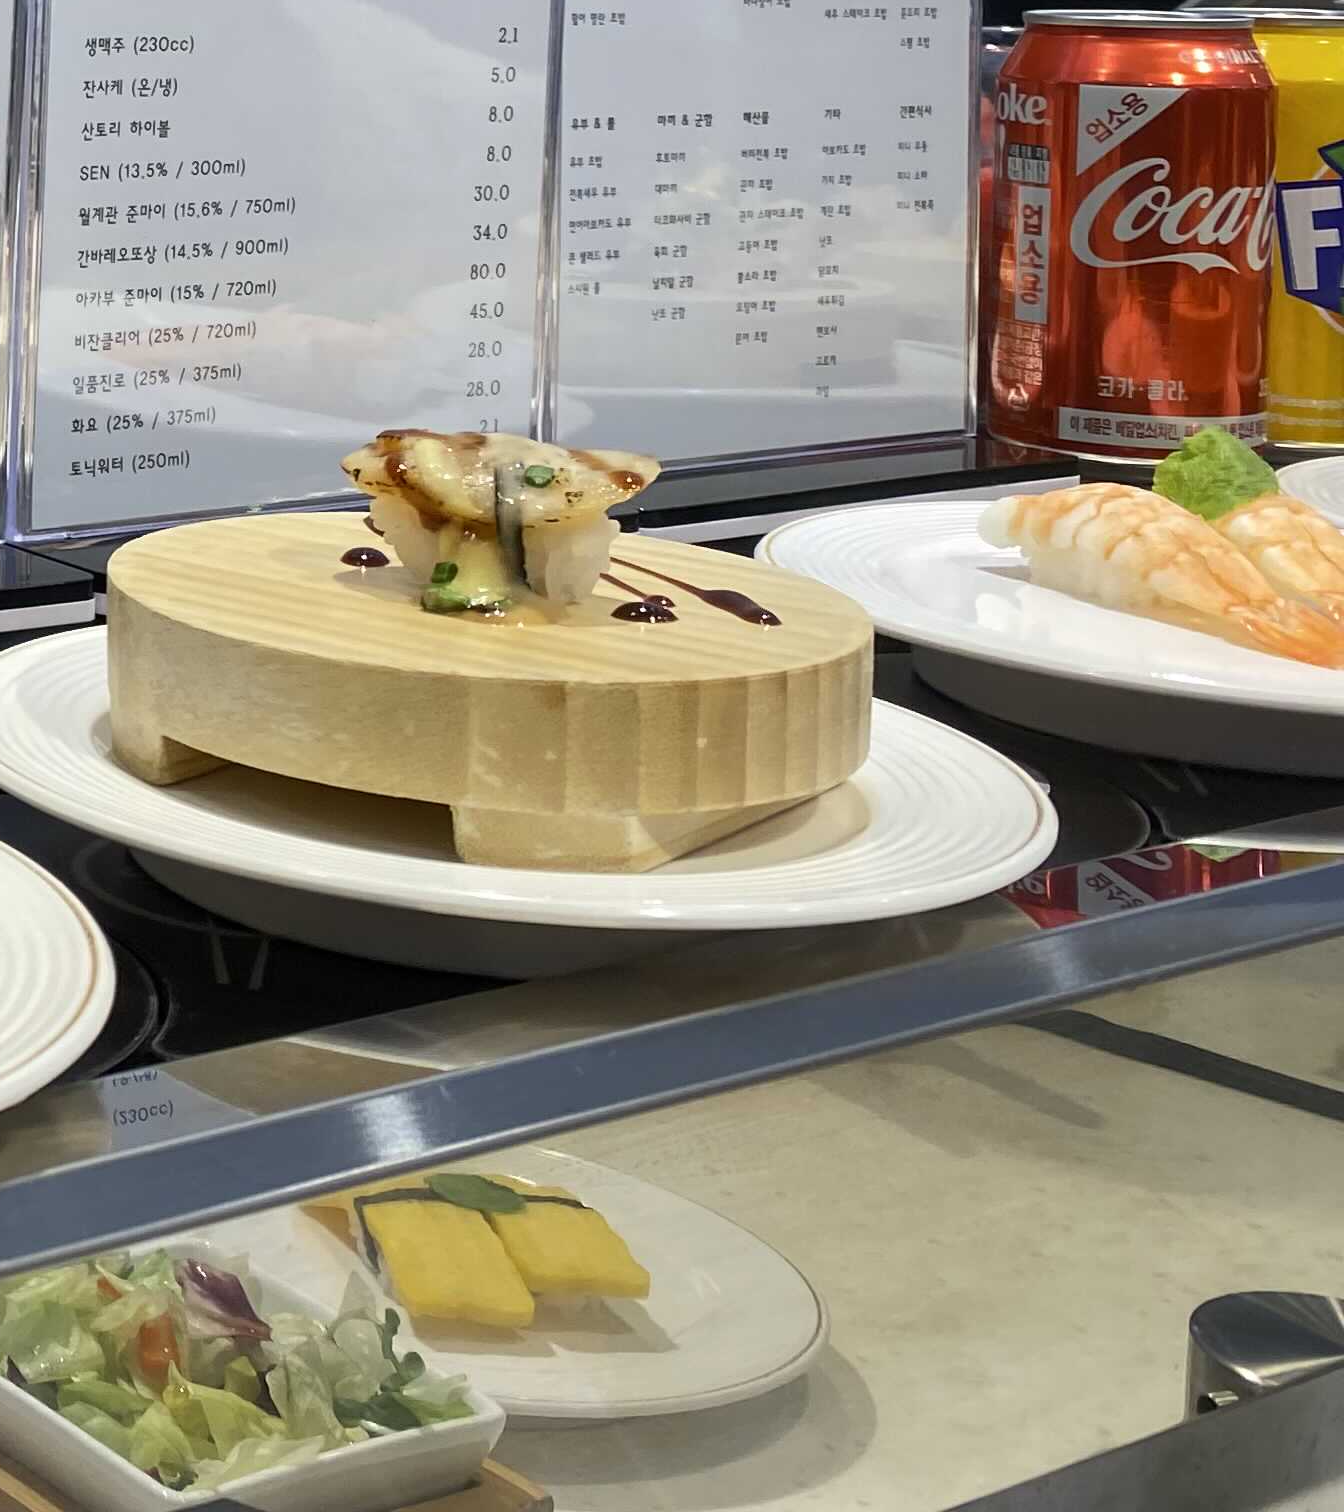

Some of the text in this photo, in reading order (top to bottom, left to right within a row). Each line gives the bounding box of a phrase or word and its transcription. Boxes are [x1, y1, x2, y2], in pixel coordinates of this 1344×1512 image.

[84, 35, 195, 58] 생맥주 (230cc)
[995, 85, 1047, 126] oke
[1084, 91, 1150, 143] 업소용
[80, 119, 171, 142] 산토리 하이볼
[79, 158, 246, 183] SEN (13.5% / 300ml)
